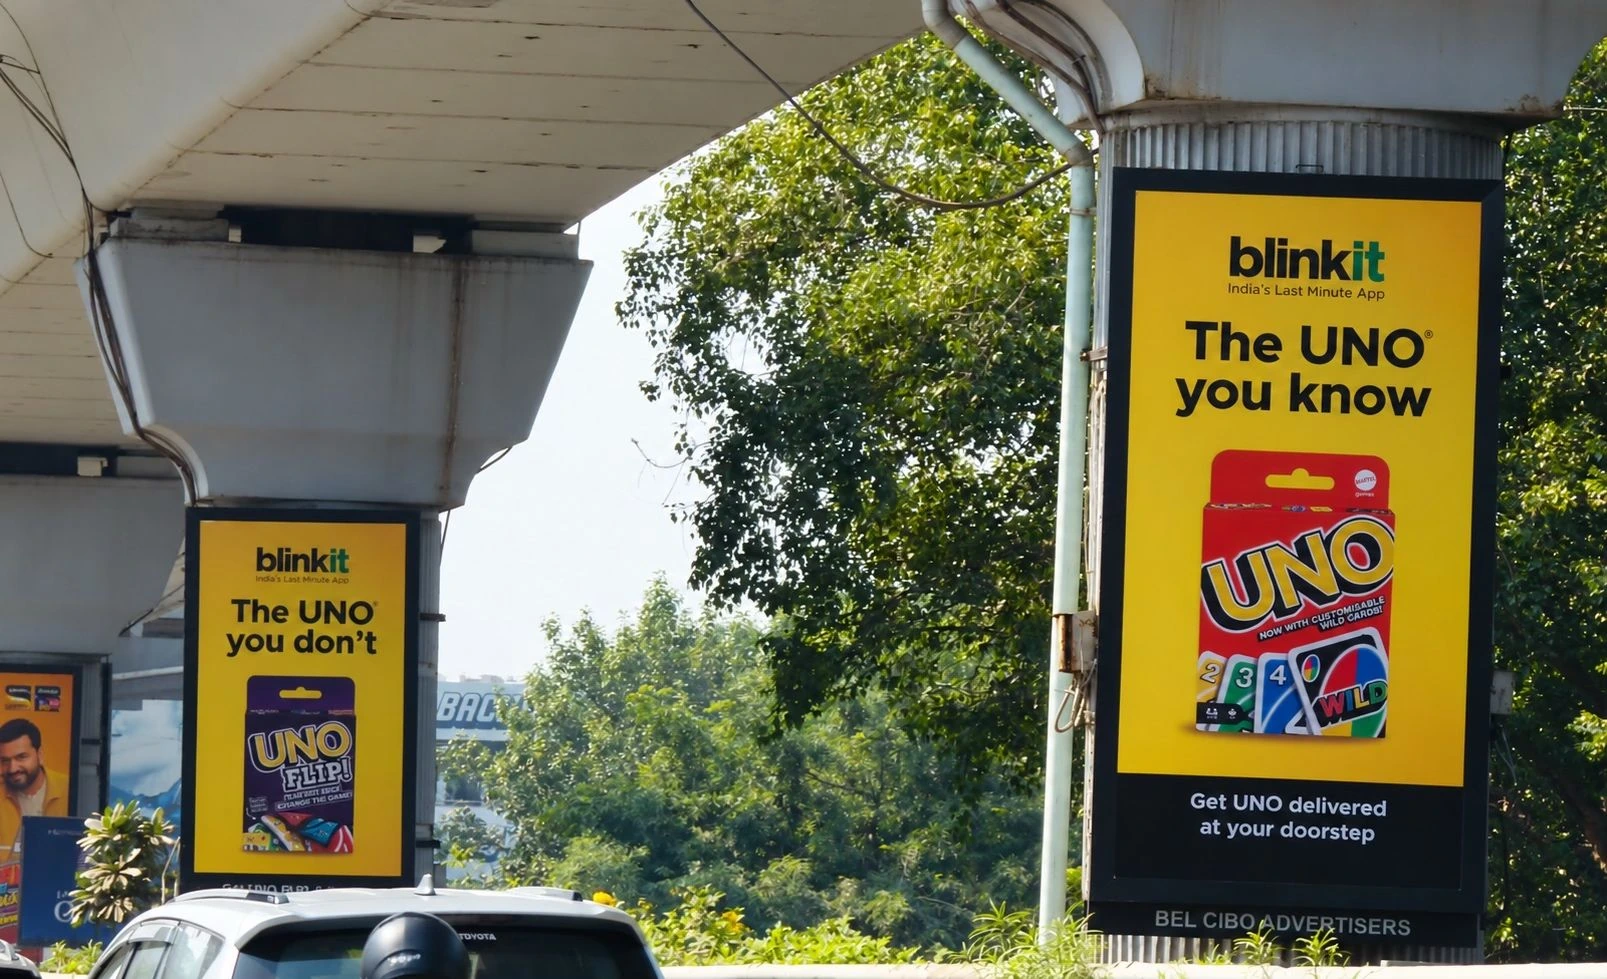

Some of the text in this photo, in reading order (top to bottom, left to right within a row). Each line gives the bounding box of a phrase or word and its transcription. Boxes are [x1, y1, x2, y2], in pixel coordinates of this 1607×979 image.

[1229, 236, 1386, 282] blinkit
[1228, 283, 1386, 301] India's Last Minute App
[1185, 320, 1283, 363] The
[1175, 372, 1432, 418] you know
[256, 547, 350, 574] blinkit
[1200, 514, 1395, 633] UNO
[255, 575, 281, 583] India's
[302, 576, 330, 584] Minute
[231, 599, 289, 624] The
[1259, 595, 1386, 640] NOW WITH CUSTOMISABLE
[1319, 605, 1384, 631] WILD CARDS!
[226, 629, 377, 658] you don't
[1200, 663, 1221, 683] 2
[1235, 667, 1254, 688] 3
[1270, 664, 1287, 685] 4
[1318, 679, 1388, 719] WILD
[248, 721, 353, 773] UNO
[283, 757, 353, 788] FLIP!
[1190, 793, 1387, 817] Get UNO delivered
[1200, 819, 1376, 845] at your doorstep
[1155, 910, 1411, 936] BEL CIBO ADVERTISERS
